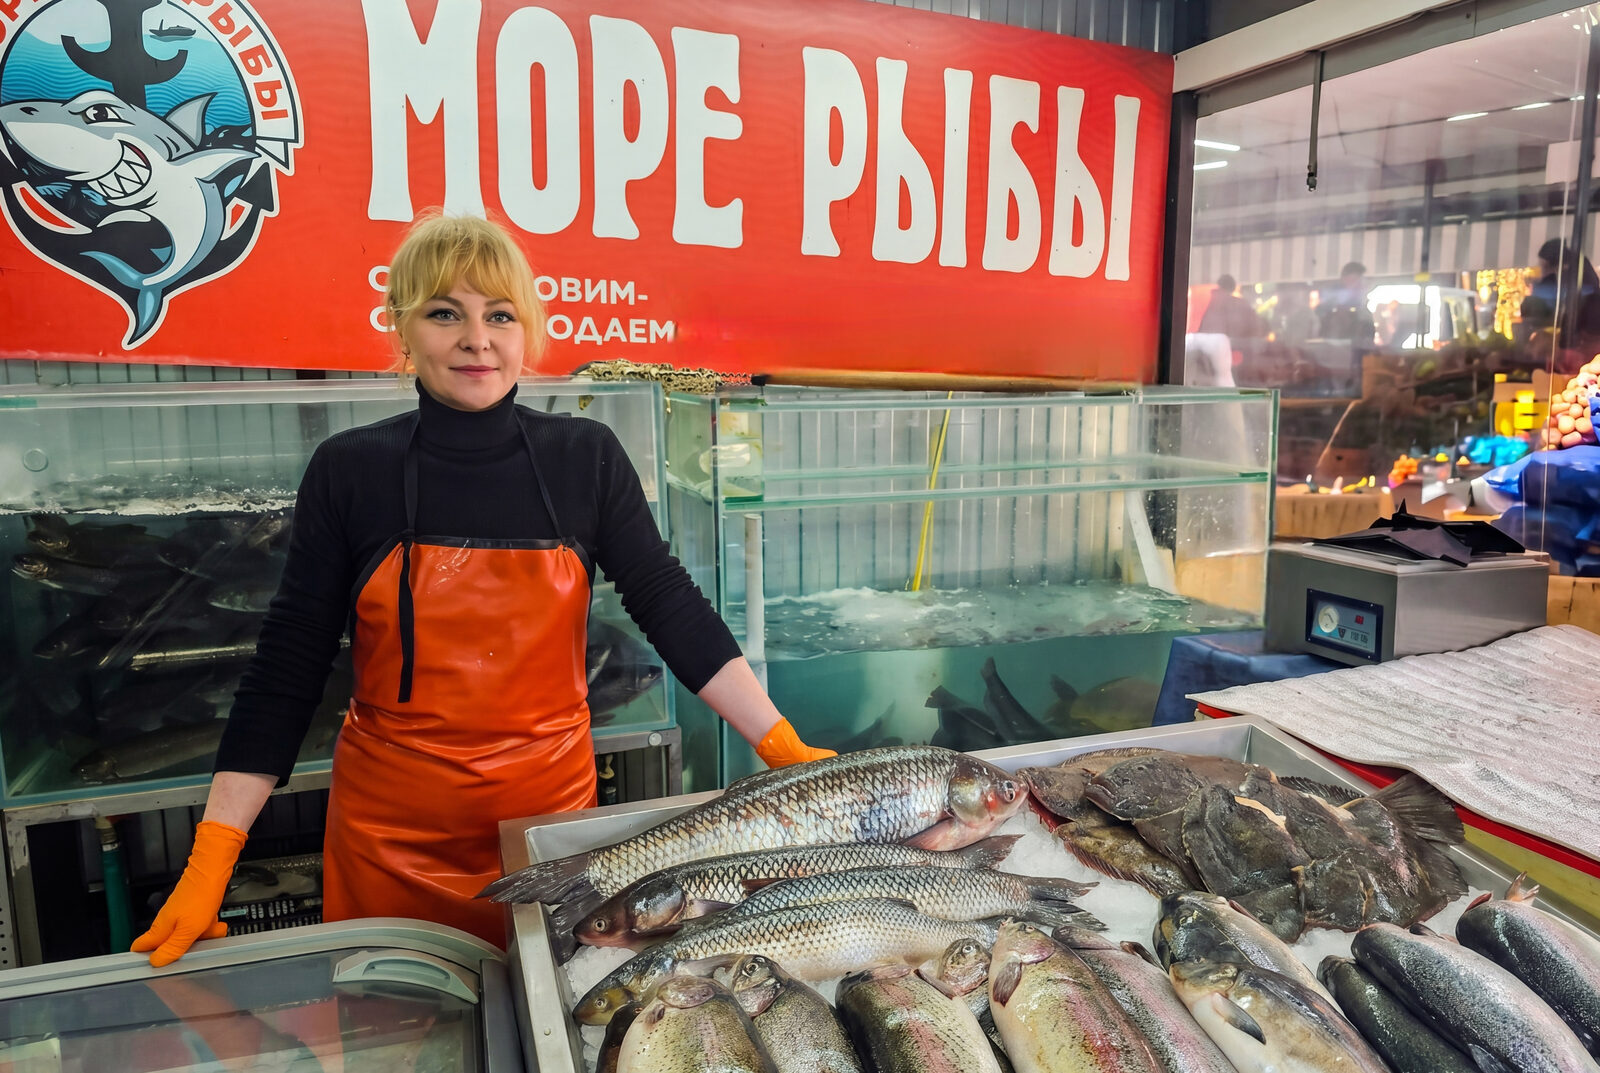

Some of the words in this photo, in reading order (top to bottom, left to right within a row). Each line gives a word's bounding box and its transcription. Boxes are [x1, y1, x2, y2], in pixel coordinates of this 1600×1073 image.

[183, 0, 288, 120] ЫБЫ
[361, 0, 743, 248] МОРЕ
[801, 46, 1141, 281] РЫБЫ
[534, 276, 648, 306] ОВИМ-
[547, 314, 675, 345] ОДАЕМ
